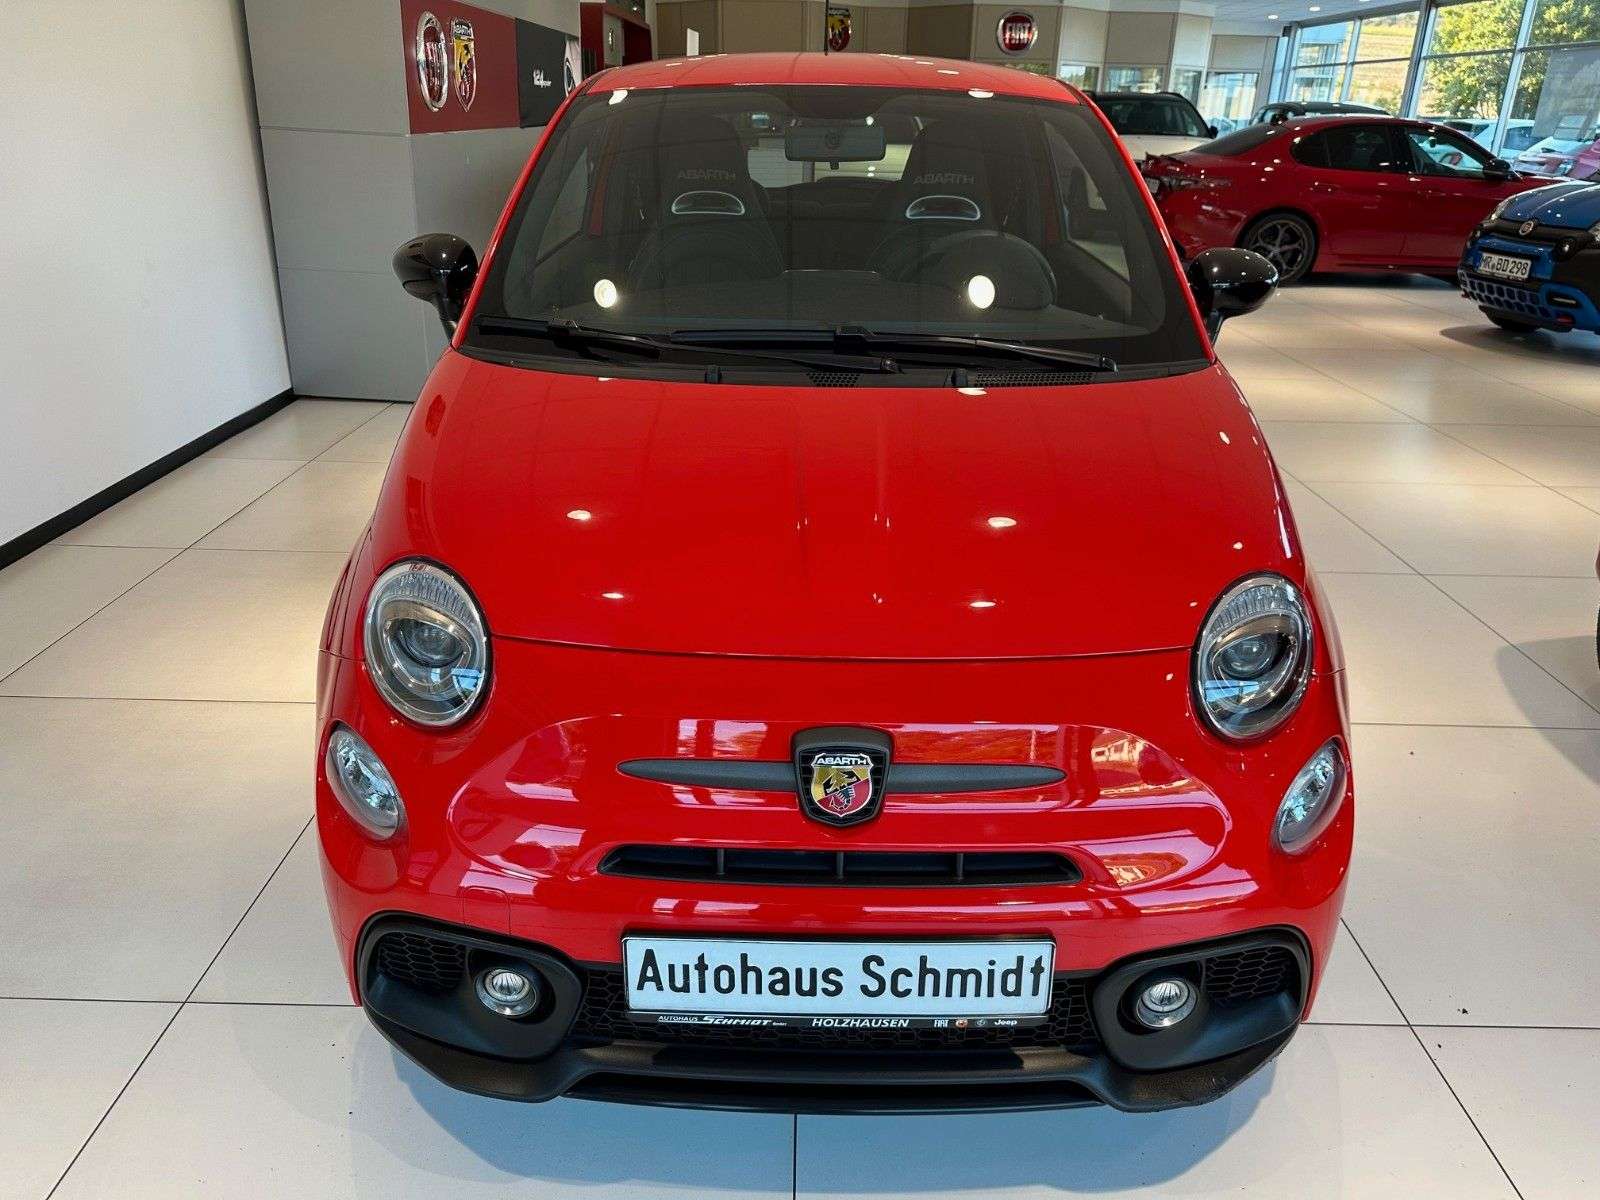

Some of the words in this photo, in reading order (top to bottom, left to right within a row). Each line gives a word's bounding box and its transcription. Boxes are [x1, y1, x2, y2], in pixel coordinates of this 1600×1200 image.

[1005, 22, 1031, 44] FIAT
[677, 168, 737, 180] ABARTH
[912, 172, 976, 185] ABARTH
[1496, 258, 1509, 272] BD
[1510, 260, 1529, 275] 298
[816, 756, 867, 765] ABARTH
[636, 948, 844, 998] Autohaus
[859, 954, 1045, 998] Schmidt
[702, 1015, 771, 1026] SCHMIDT
[811, 1018, 910, 1028] HOLZHAUSEN
[933, 1019, 949, 1028] FIAT
[994, 1019, 1018, 1027] Jeep
